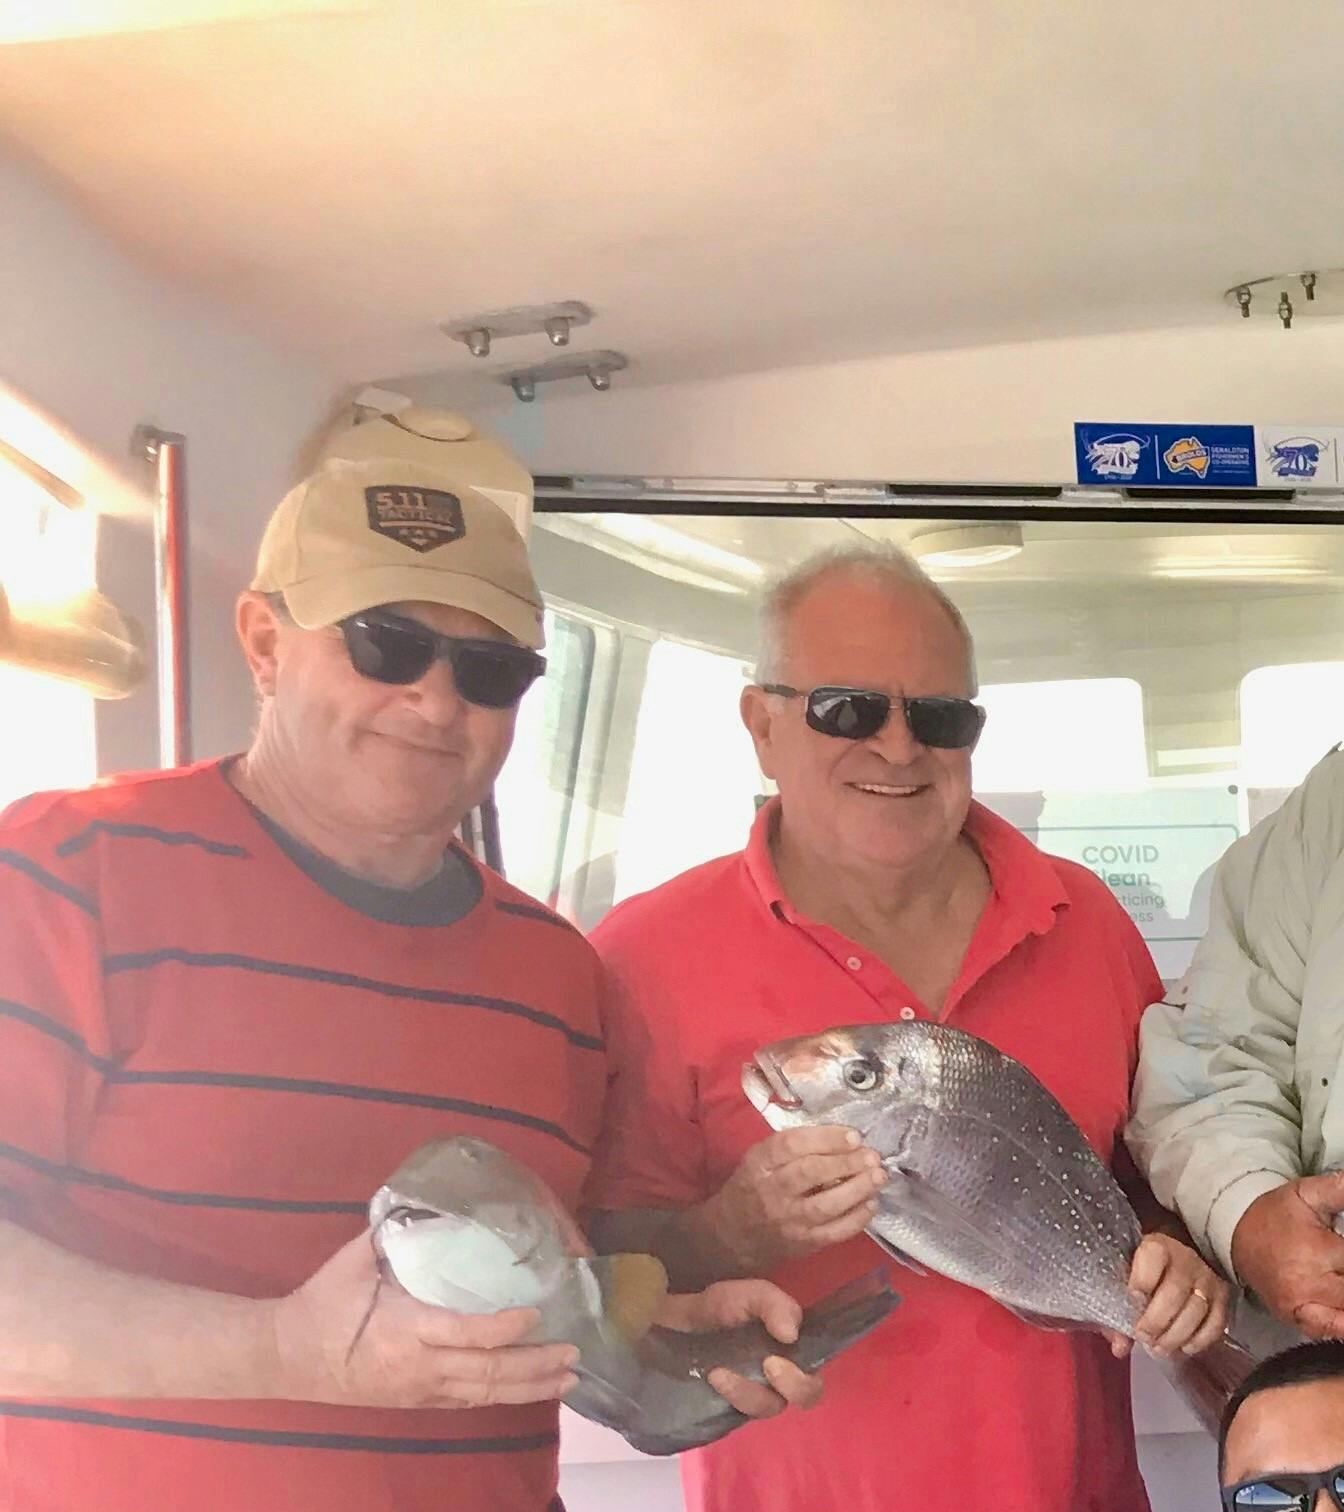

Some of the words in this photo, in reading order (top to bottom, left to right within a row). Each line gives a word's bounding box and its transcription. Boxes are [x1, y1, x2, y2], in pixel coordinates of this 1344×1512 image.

[1082, 845, 1159, 864] COVID
[1101, 868, 1150, 887] lean
[1119, 892, 1165, 909] ticing
